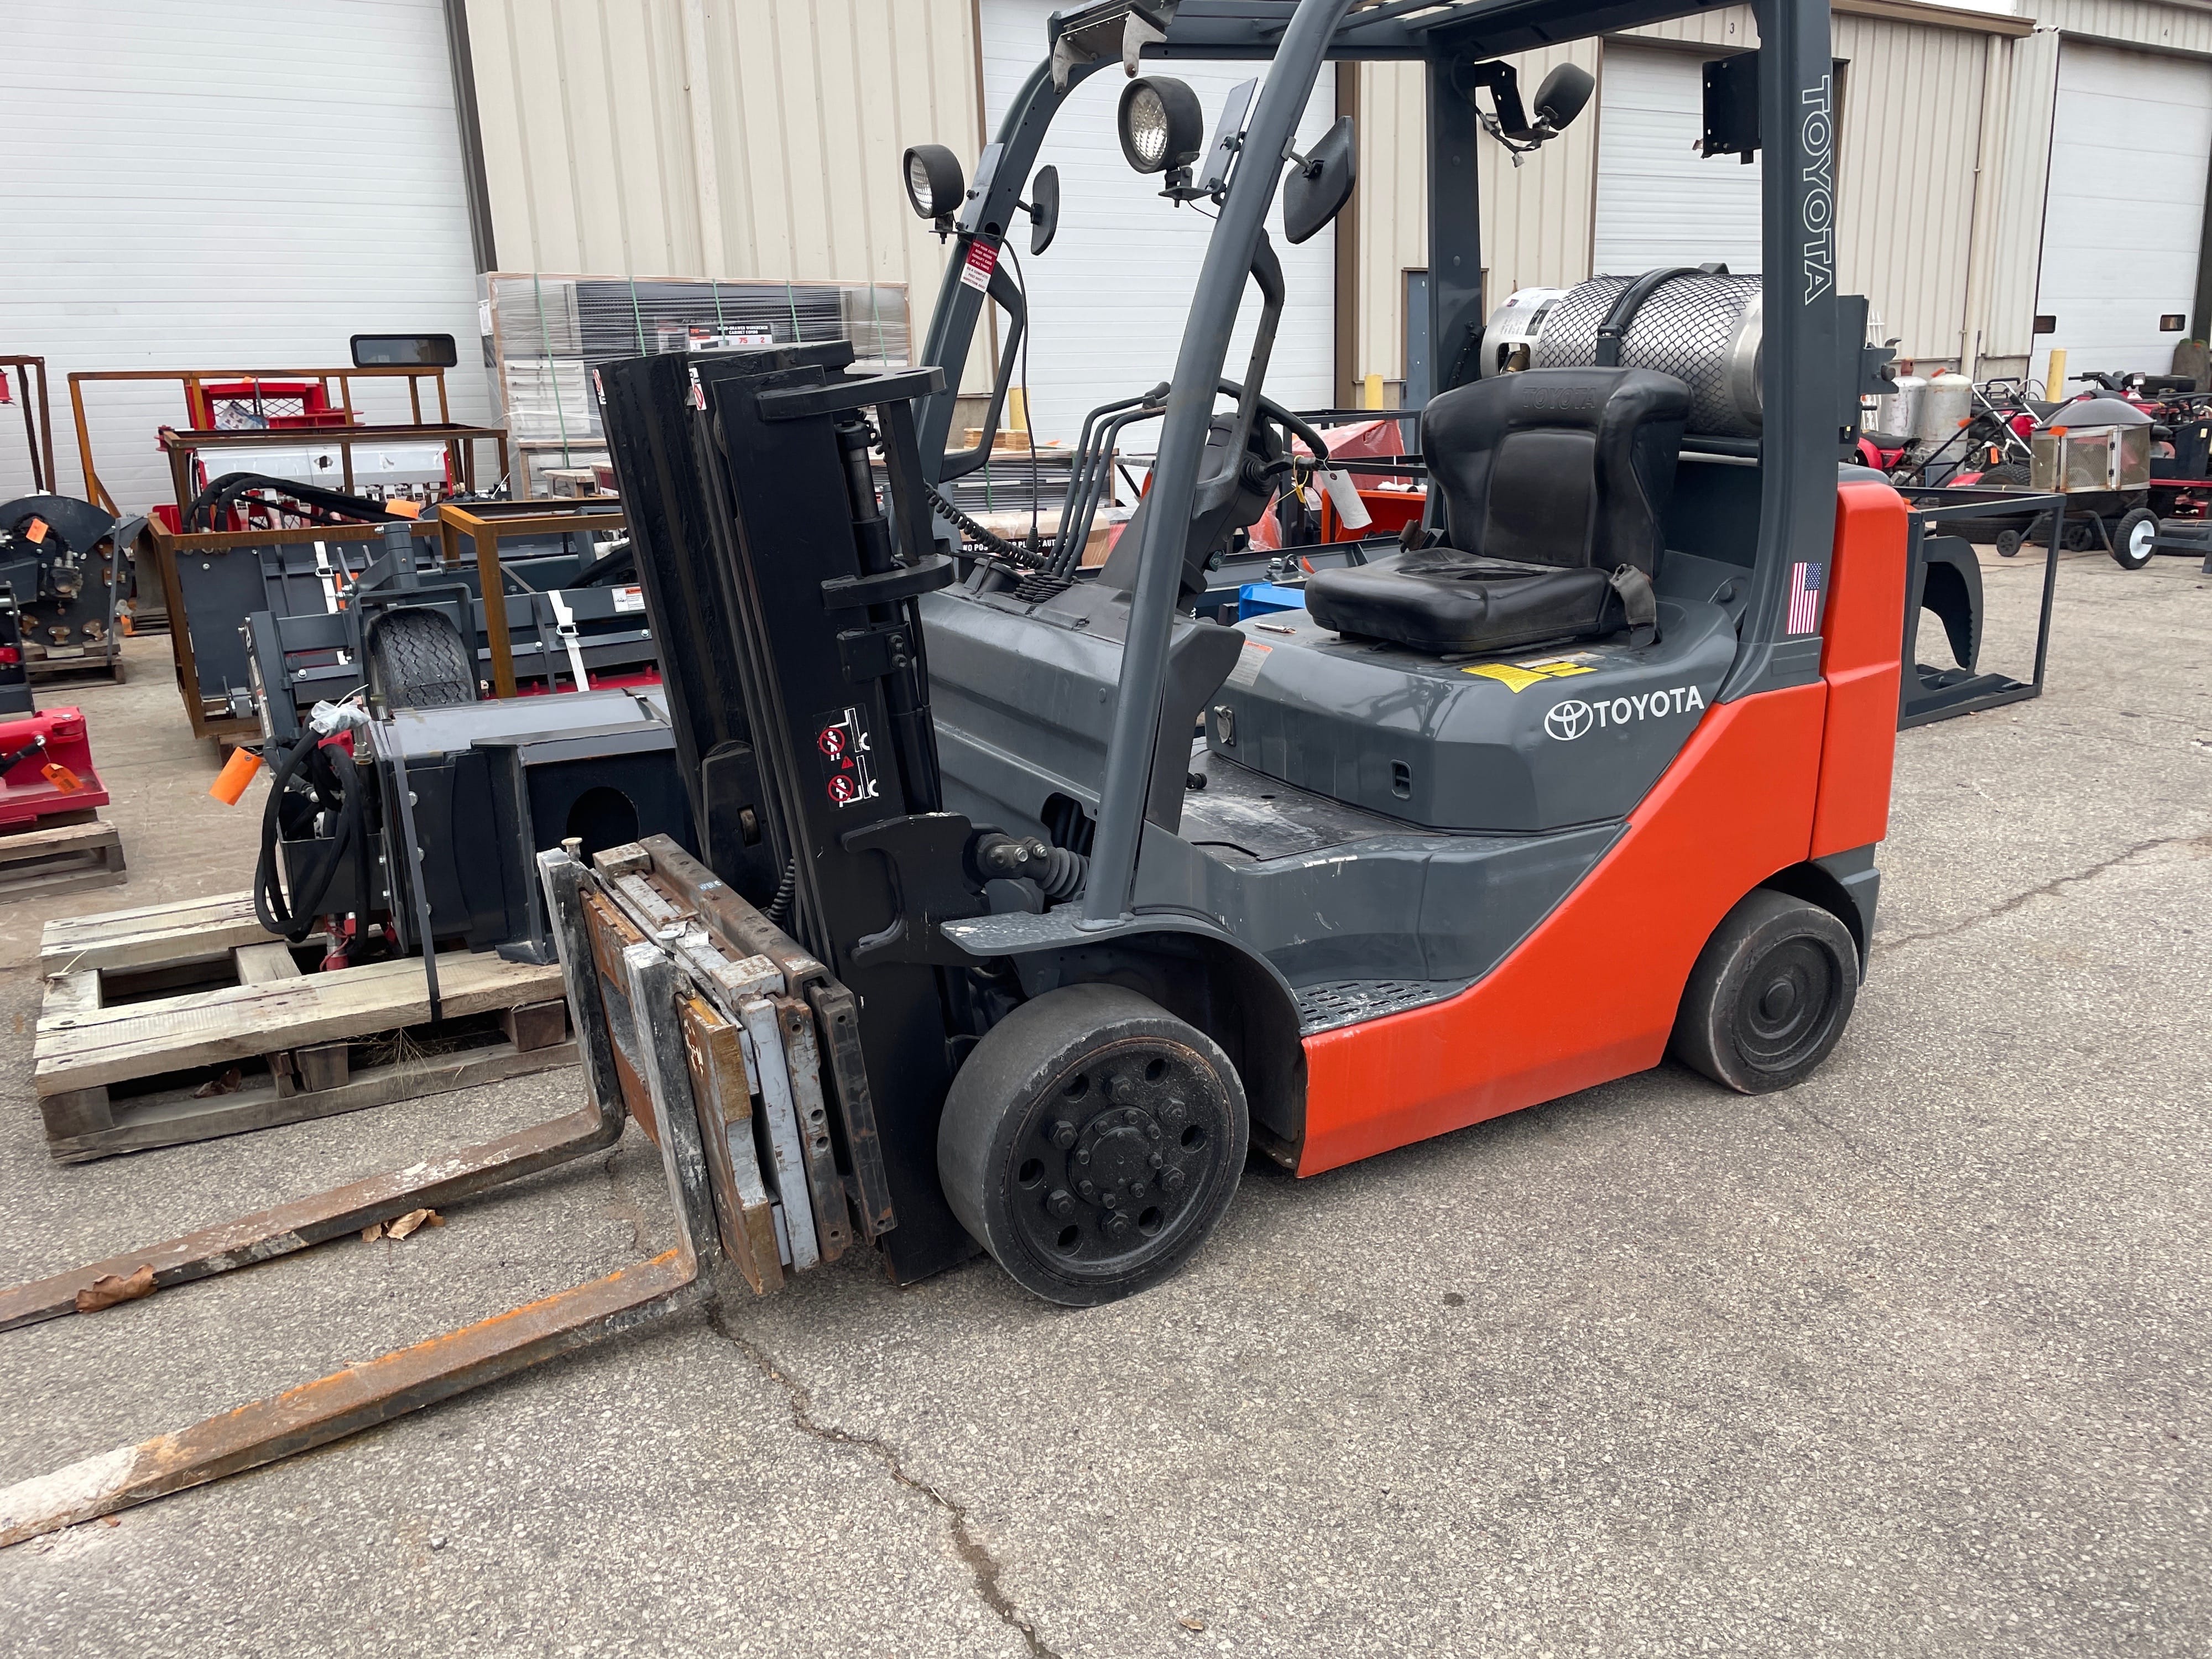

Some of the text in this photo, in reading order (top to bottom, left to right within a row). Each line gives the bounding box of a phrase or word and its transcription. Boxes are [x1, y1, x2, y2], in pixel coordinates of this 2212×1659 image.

[1729, 22, 1735, 34] 3
[1802, 75, 1832, 306] TOYOTA
[1522, 387, 1597, 409] TOYOTA
[1593, 685, 1705, 727] TOYOTA
